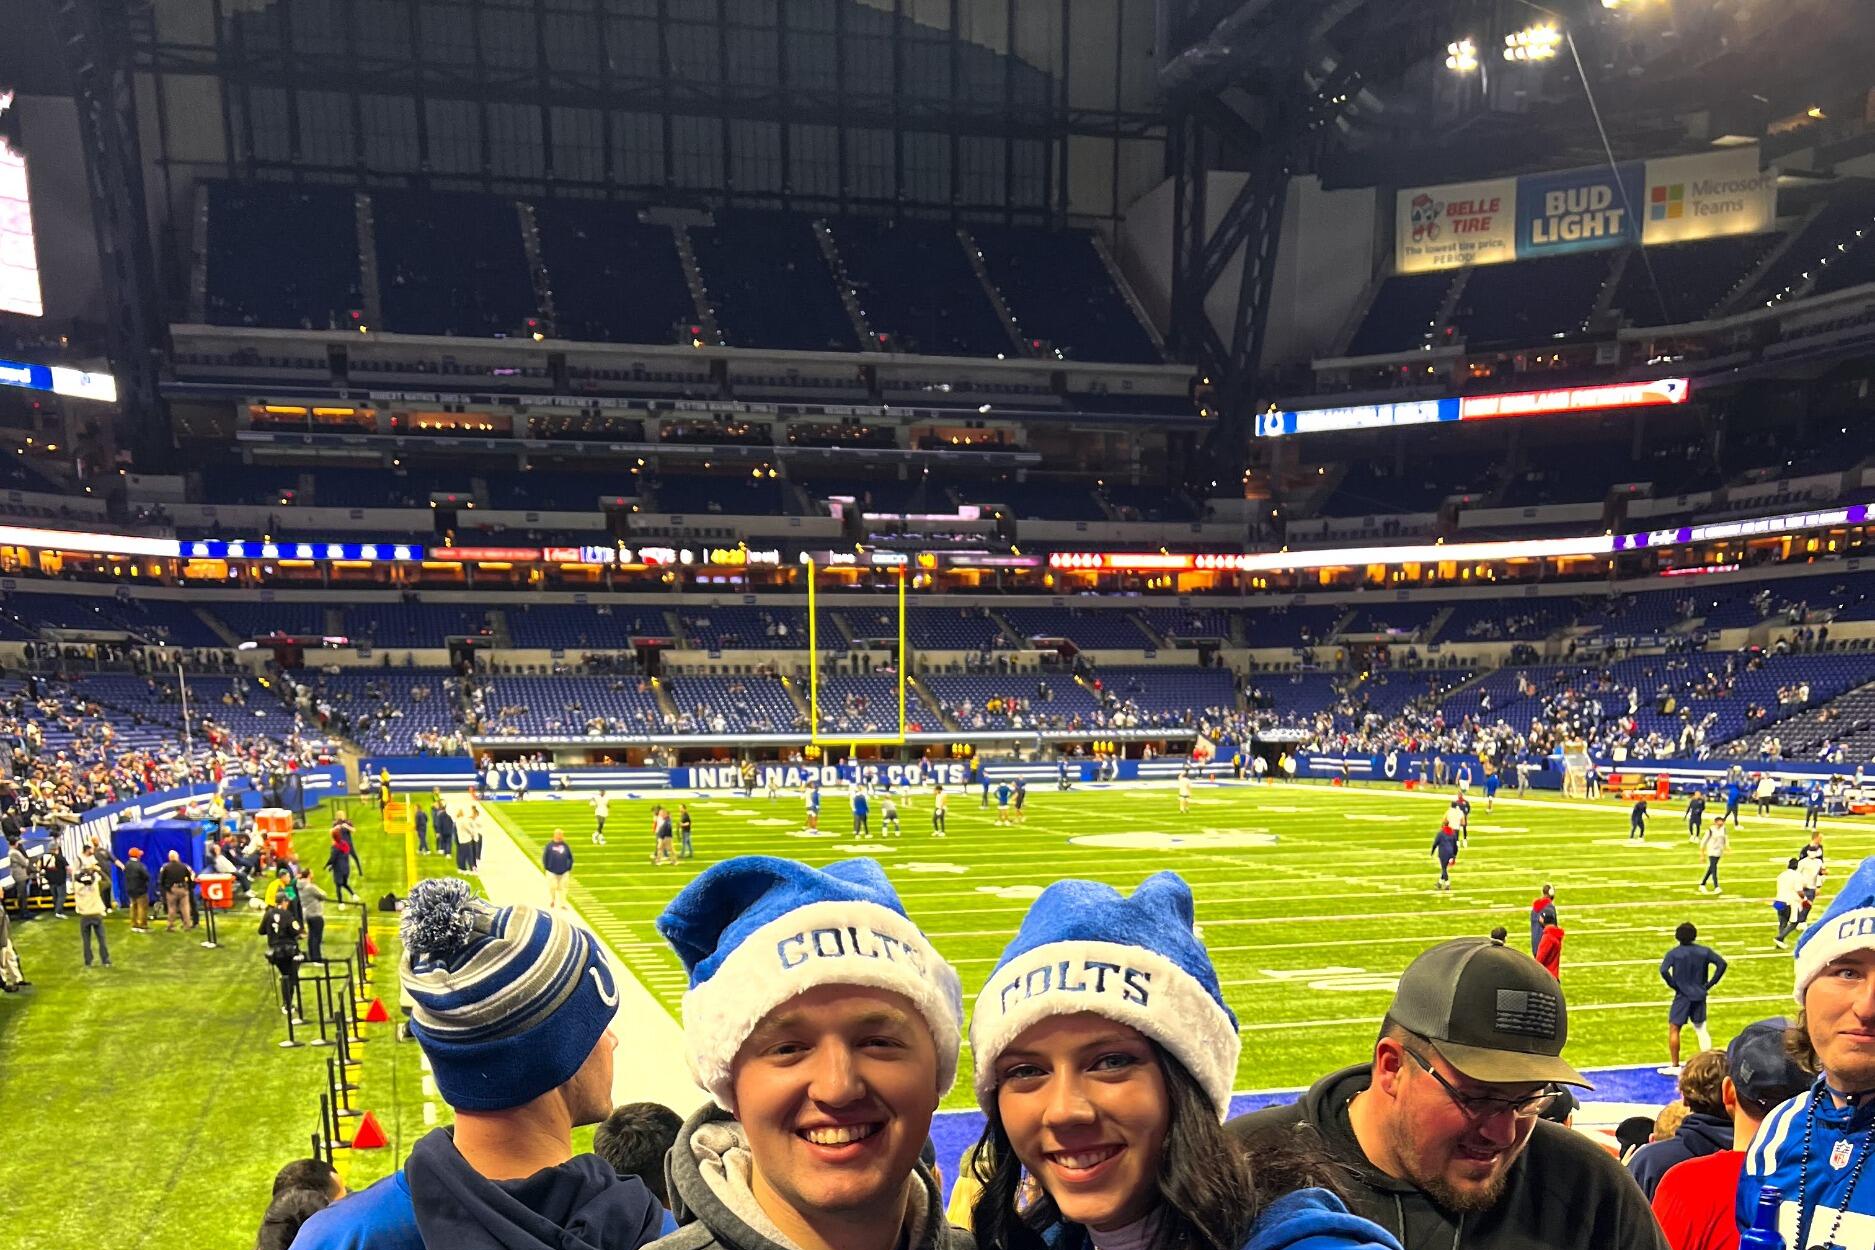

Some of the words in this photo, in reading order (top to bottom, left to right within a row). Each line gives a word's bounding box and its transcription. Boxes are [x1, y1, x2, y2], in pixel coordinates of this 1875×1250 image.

[1692, 175, 1772, 197] Microsoft
[1446, 198, 1501, 217] BELLE
[1546, 185, 1612, 217] BUD
[1693, 199, 1744, 216] Teams
[1452, 217, 1492, 234] TIRE
[1533, 208, 1624, 244] LIGHT
[208, 884, 223, 899] G
[1001, 961, 1152, 1015] COLTS
